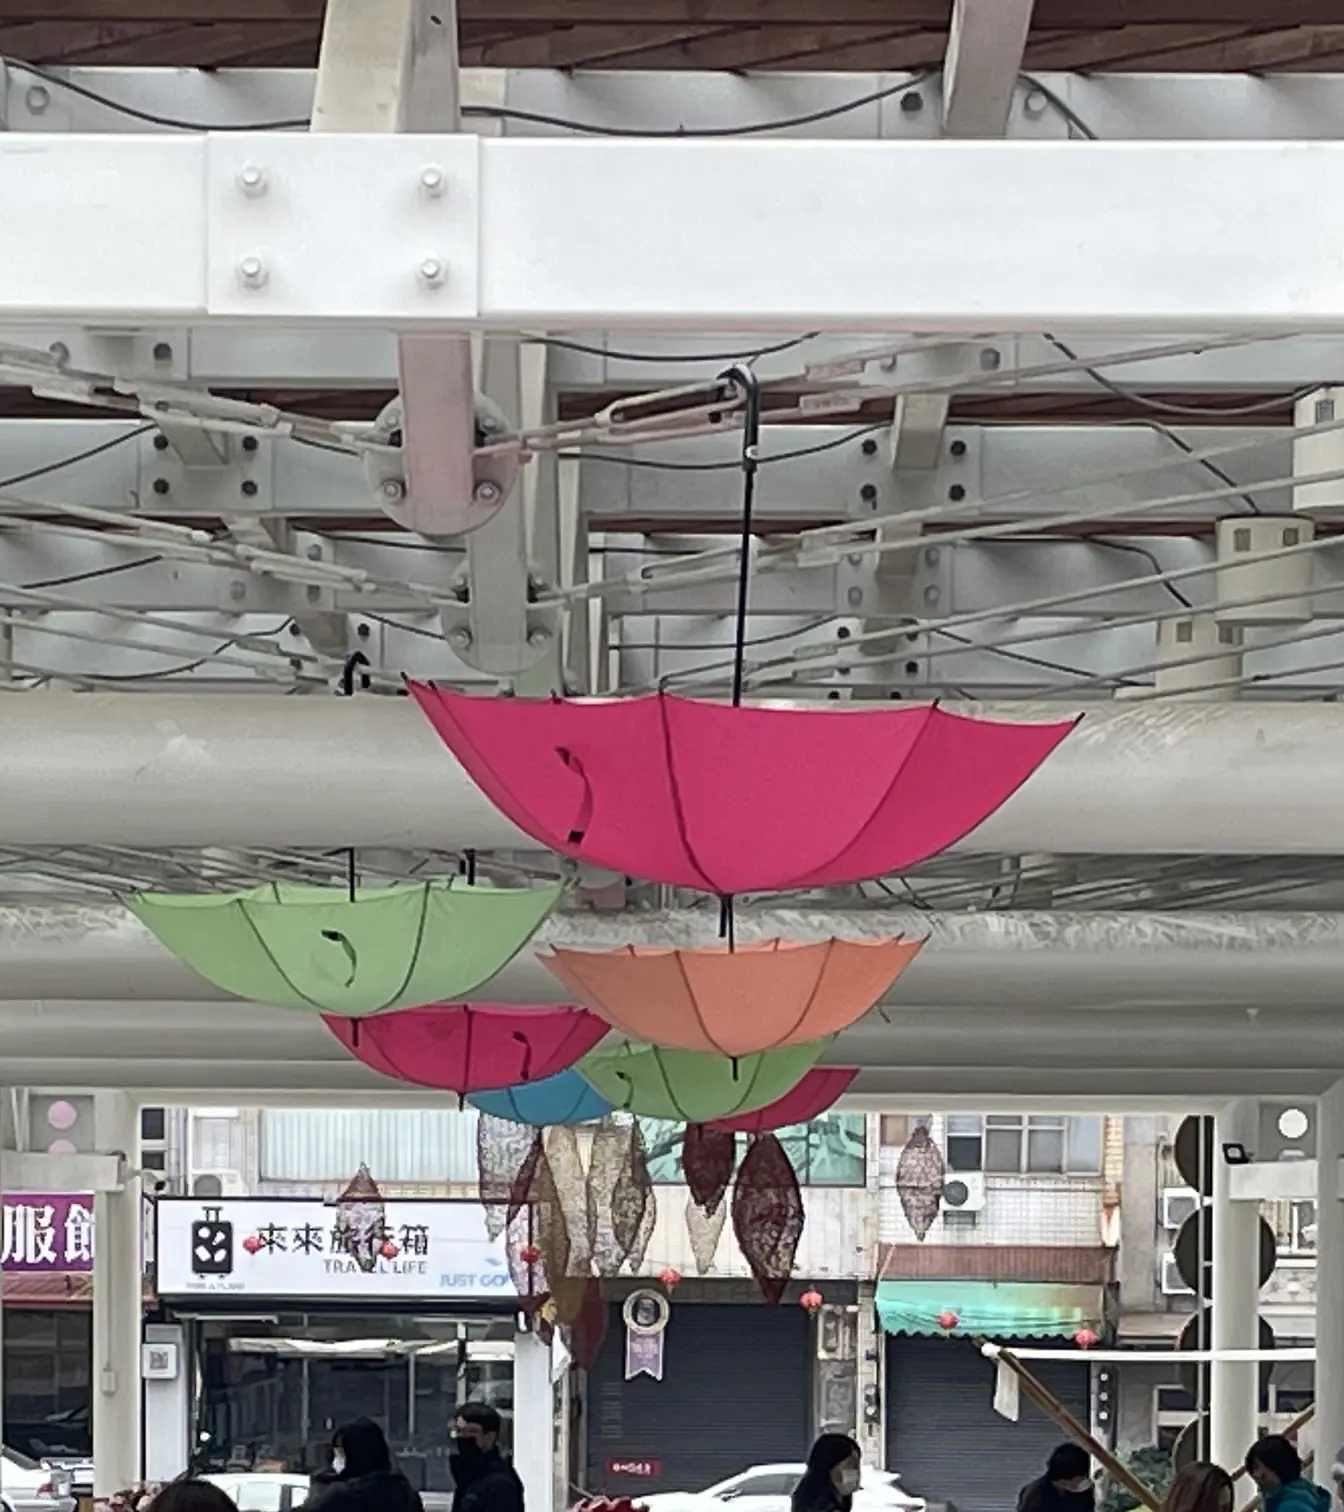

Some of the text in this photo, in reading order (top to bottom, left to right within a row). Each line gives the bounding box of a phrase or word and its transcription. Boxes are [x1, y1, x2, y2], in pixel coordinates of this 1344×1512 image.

[324, 1258, 428, 1275] TRAL LIFE
[439, 1273, 476, 1288] JUST
